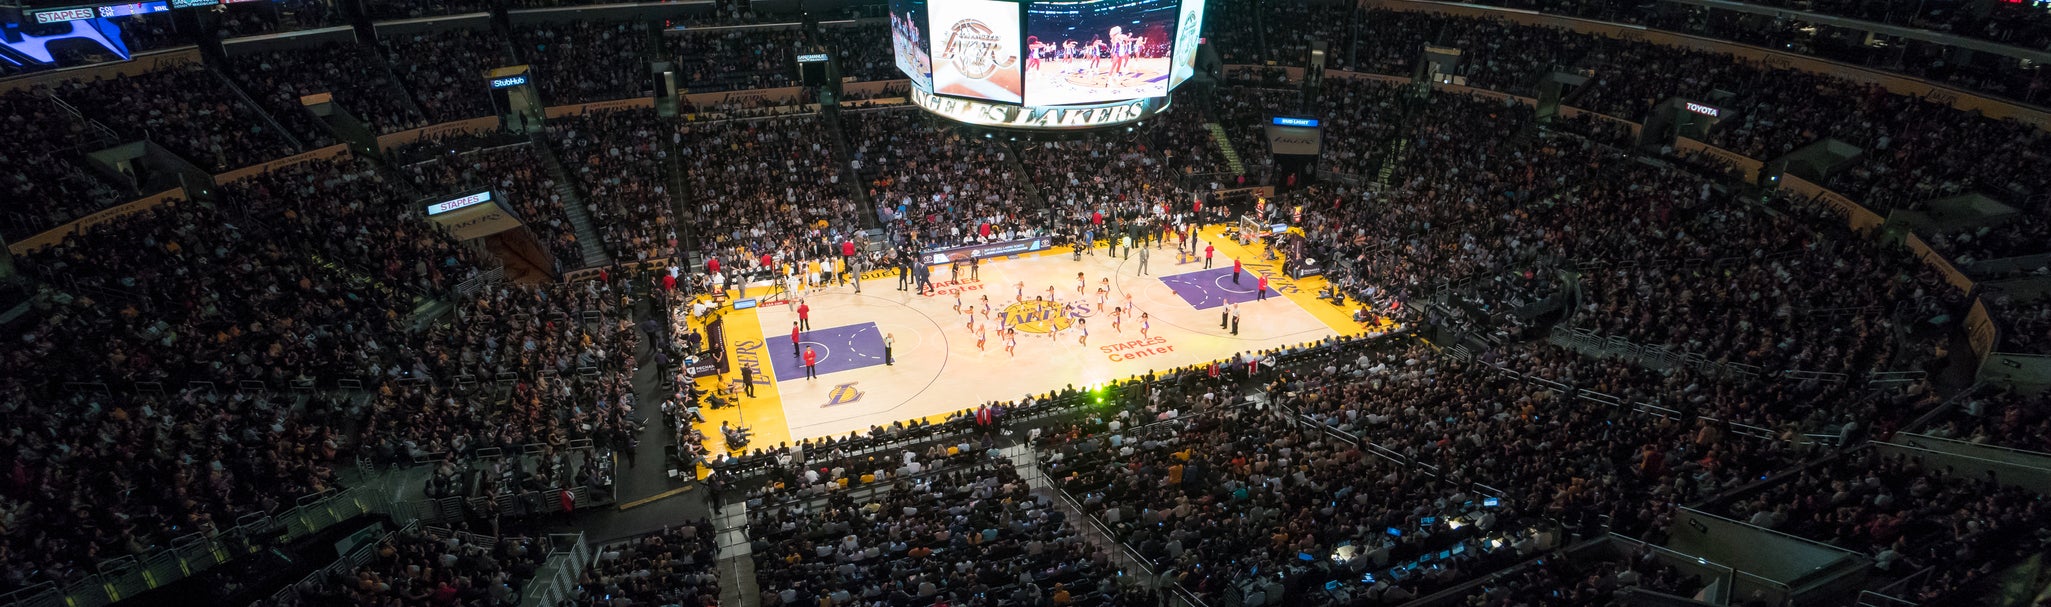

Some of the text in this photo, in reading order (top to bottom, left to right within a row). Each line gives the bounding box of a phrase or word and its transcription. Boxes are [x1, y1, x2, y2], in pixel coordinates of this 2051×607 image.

[38, 9, 92, 23] STAPLES
[494, 77, 525, 87] StubHub
[911, 87, 1009, 125] ANGELES
[1013, 99, 1144, 128] LAKERS
[1686, 102, 1718, 117] TOYOTA
[440, 195, 480, 211] STAPLES
[1100, 336, 1168, 354] STAPLES
[1108, 345, 1175, 362] Center
